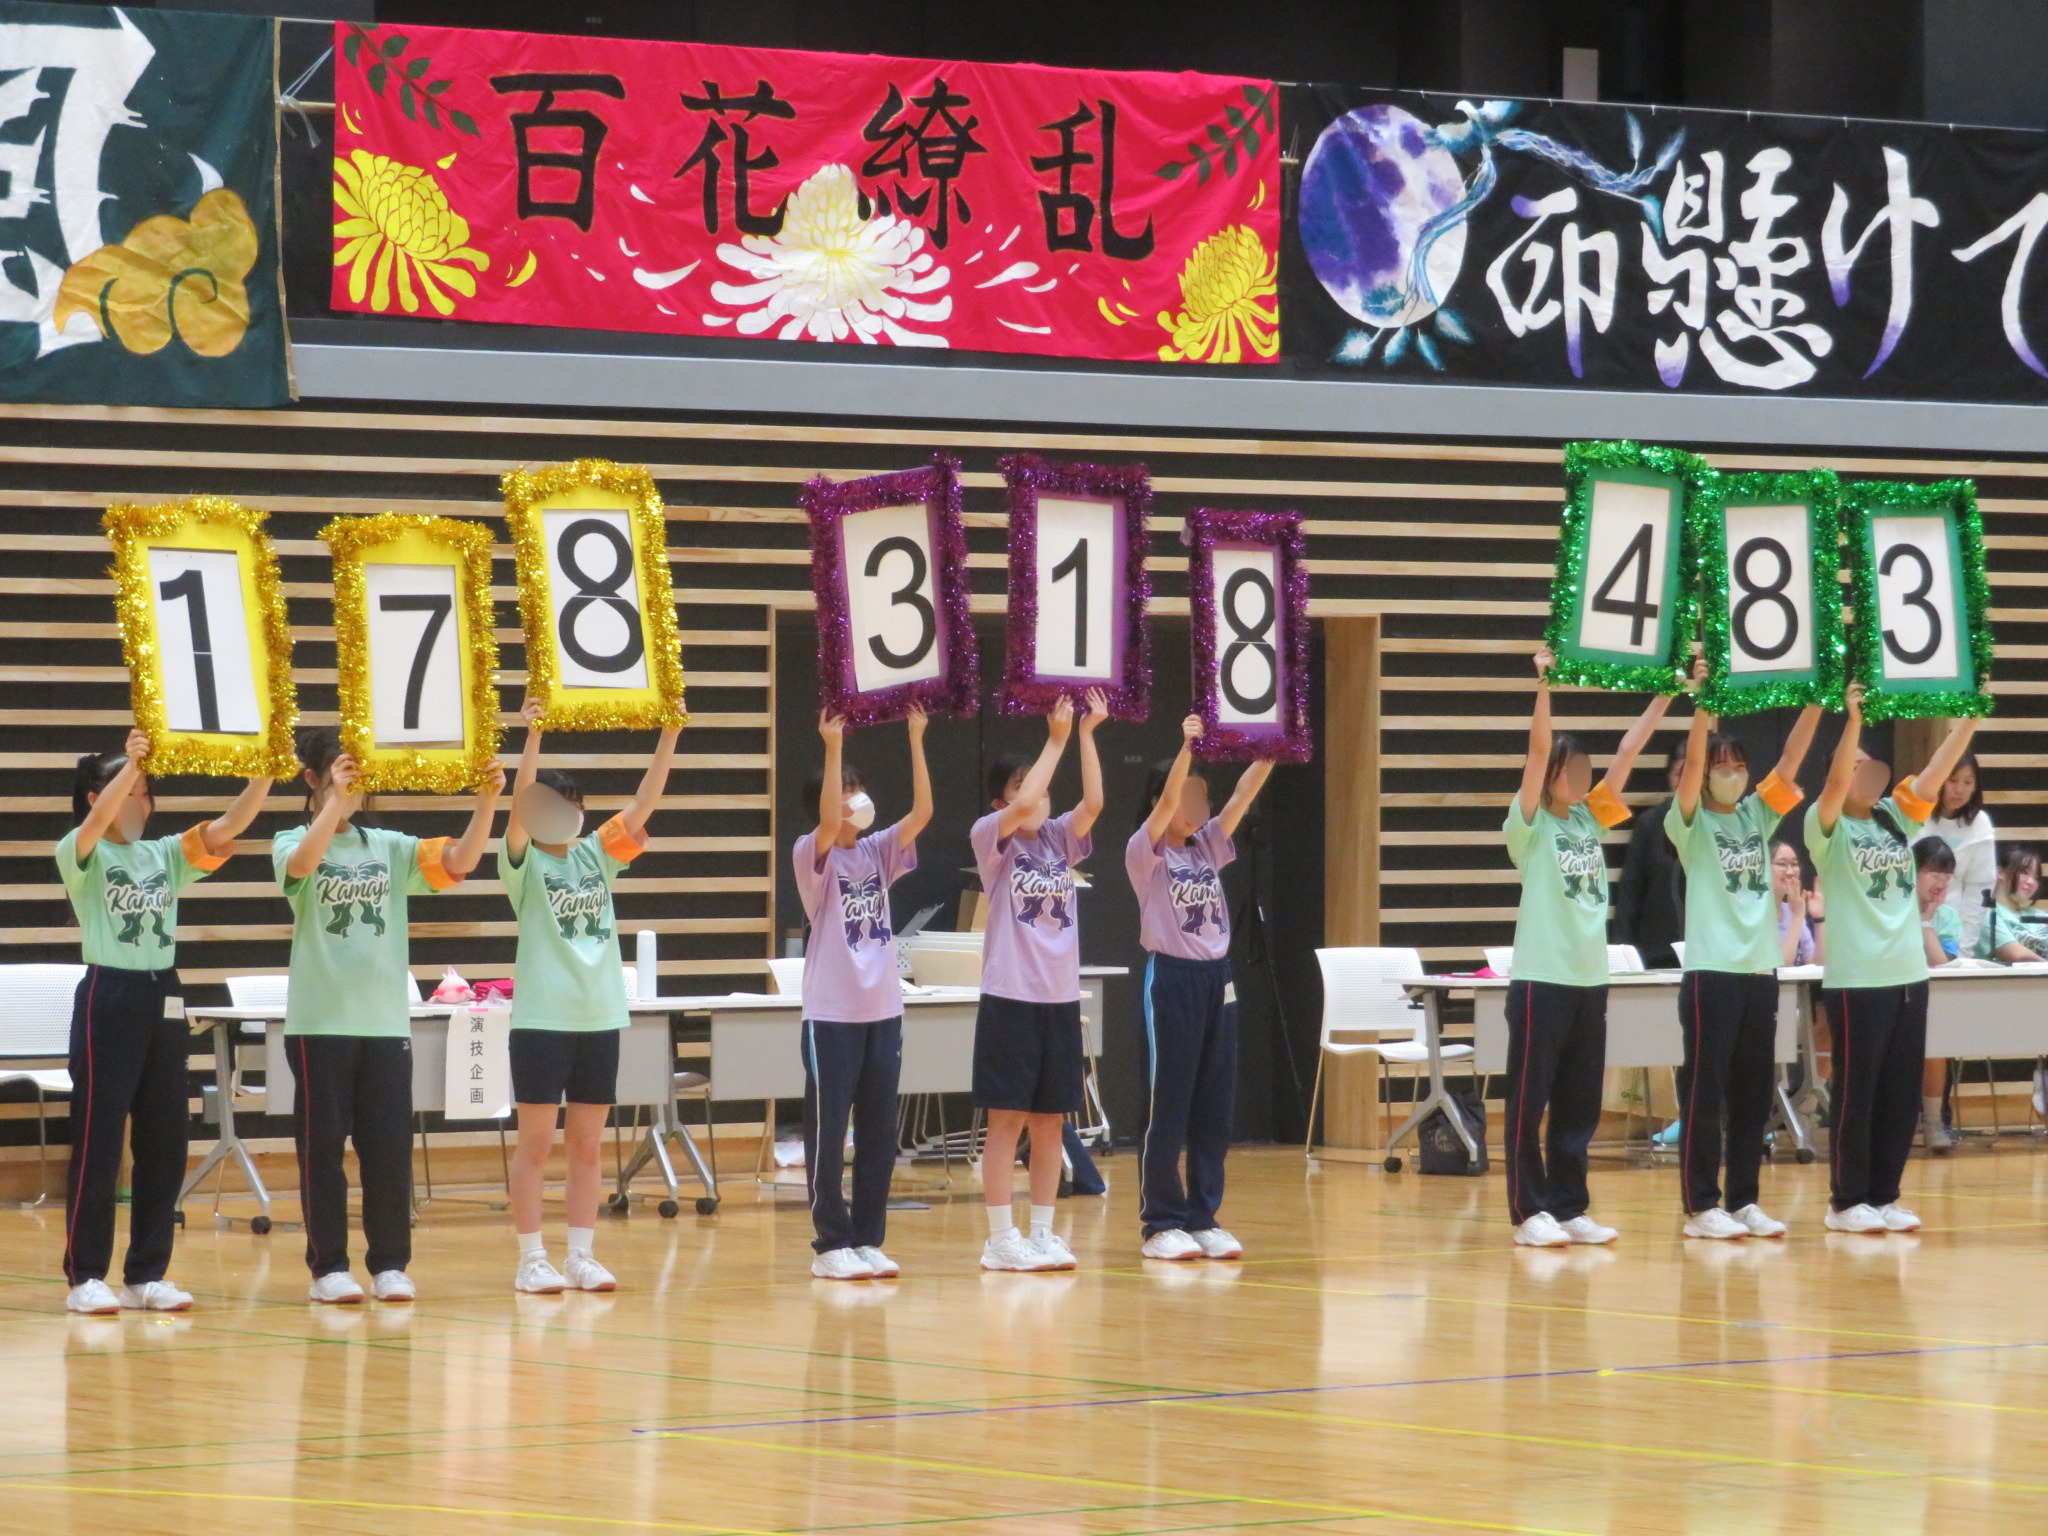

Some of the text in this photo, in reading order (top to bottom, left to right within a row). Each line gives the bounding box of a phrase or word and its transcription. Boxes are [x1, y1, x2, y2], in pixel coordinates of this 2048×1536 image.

[489, 72, 1155, 262] 百花繚乱
[158, 569, 222, 731] 1
[556, 518, 645, 673] 8
[863, 536, 938, 670] 3
[1051, 538, 1088, 667] 1
[1219, 567, 1277, 715] 8
[1590, 523, 1659, 646] 4
[1730, 536, 1799, 661] 8
[1877, 543, 1942, 665] 3
[379, 593, 452, 730] 7
[469, 1016, 485, 1105] 演技企画
